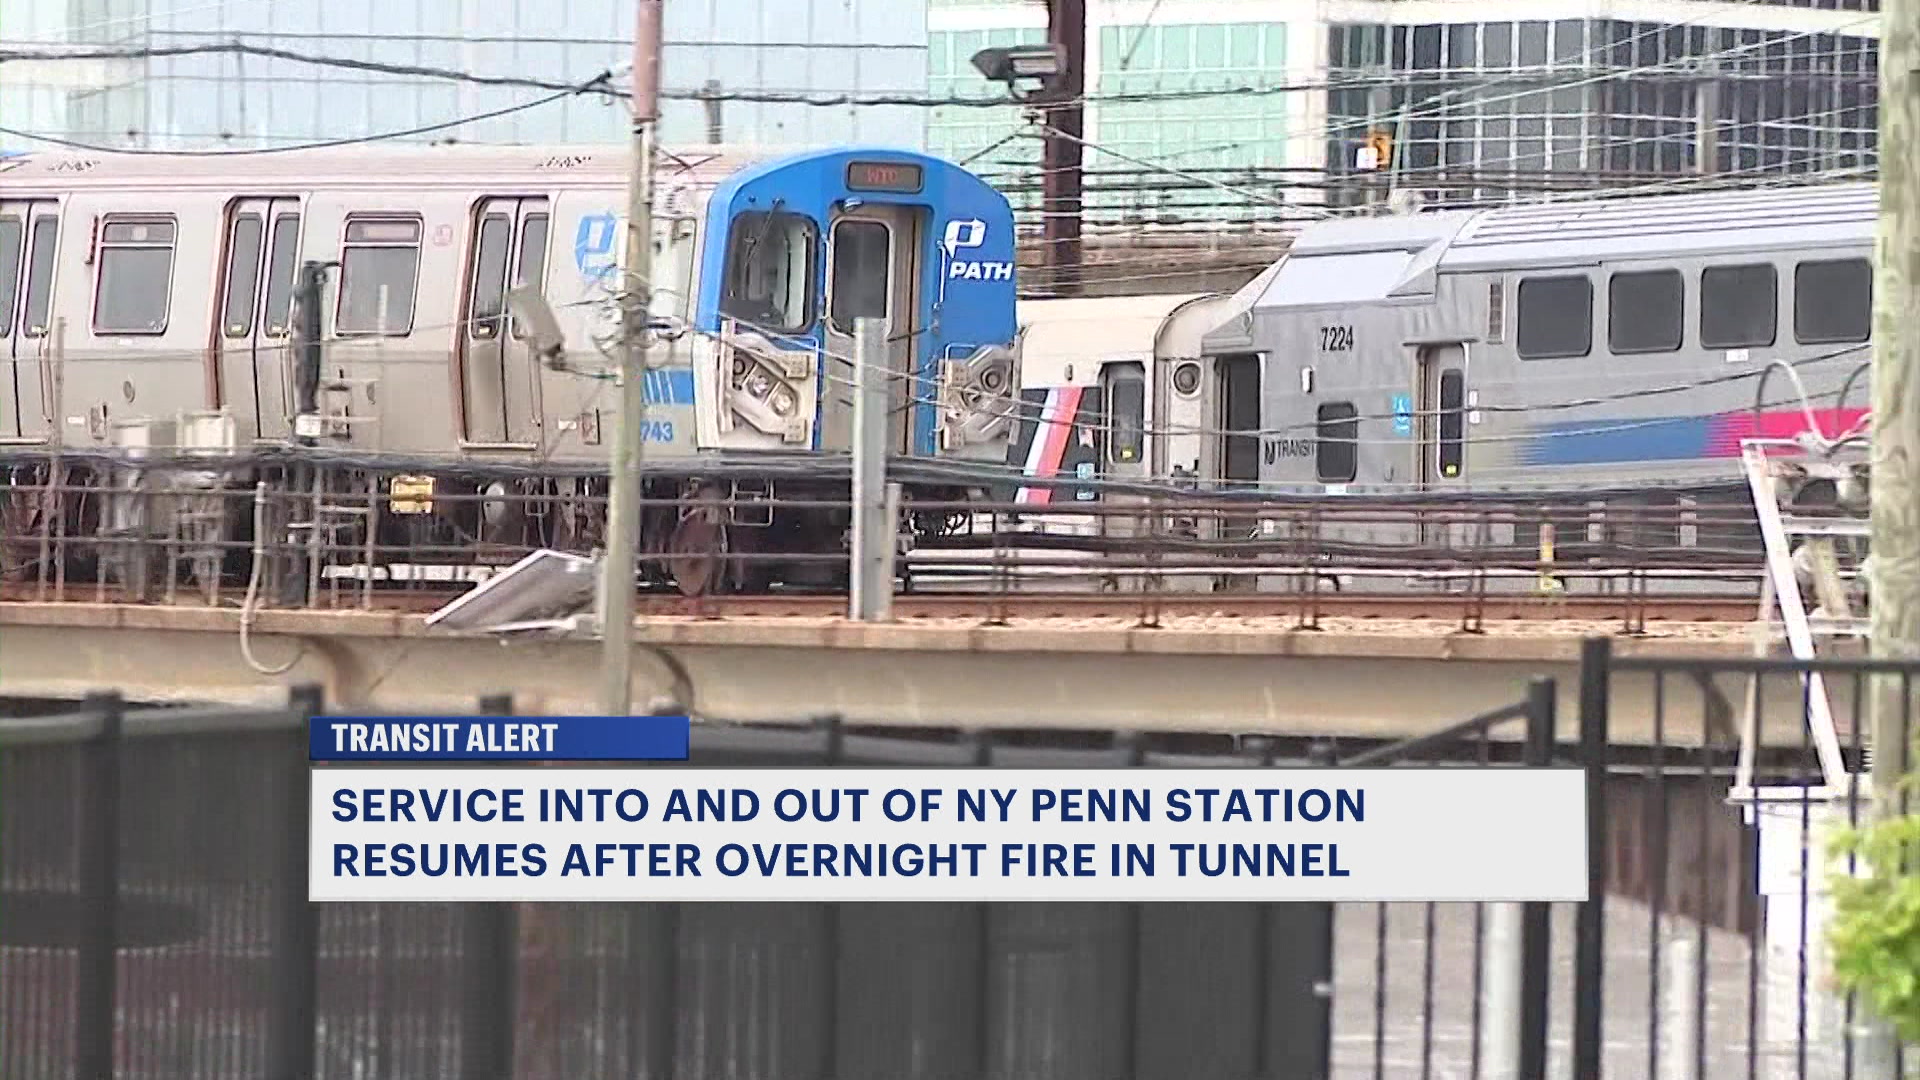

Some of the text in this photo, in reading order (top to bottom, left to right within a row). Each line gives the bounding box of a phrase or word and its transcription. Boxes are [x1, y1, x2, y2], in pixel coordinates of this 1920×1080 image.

[949, 261, 1013, 280] PATH
[1321, 326, 1353, 351] 7224
[1277, 439, 1315, 458] TRANSIT
